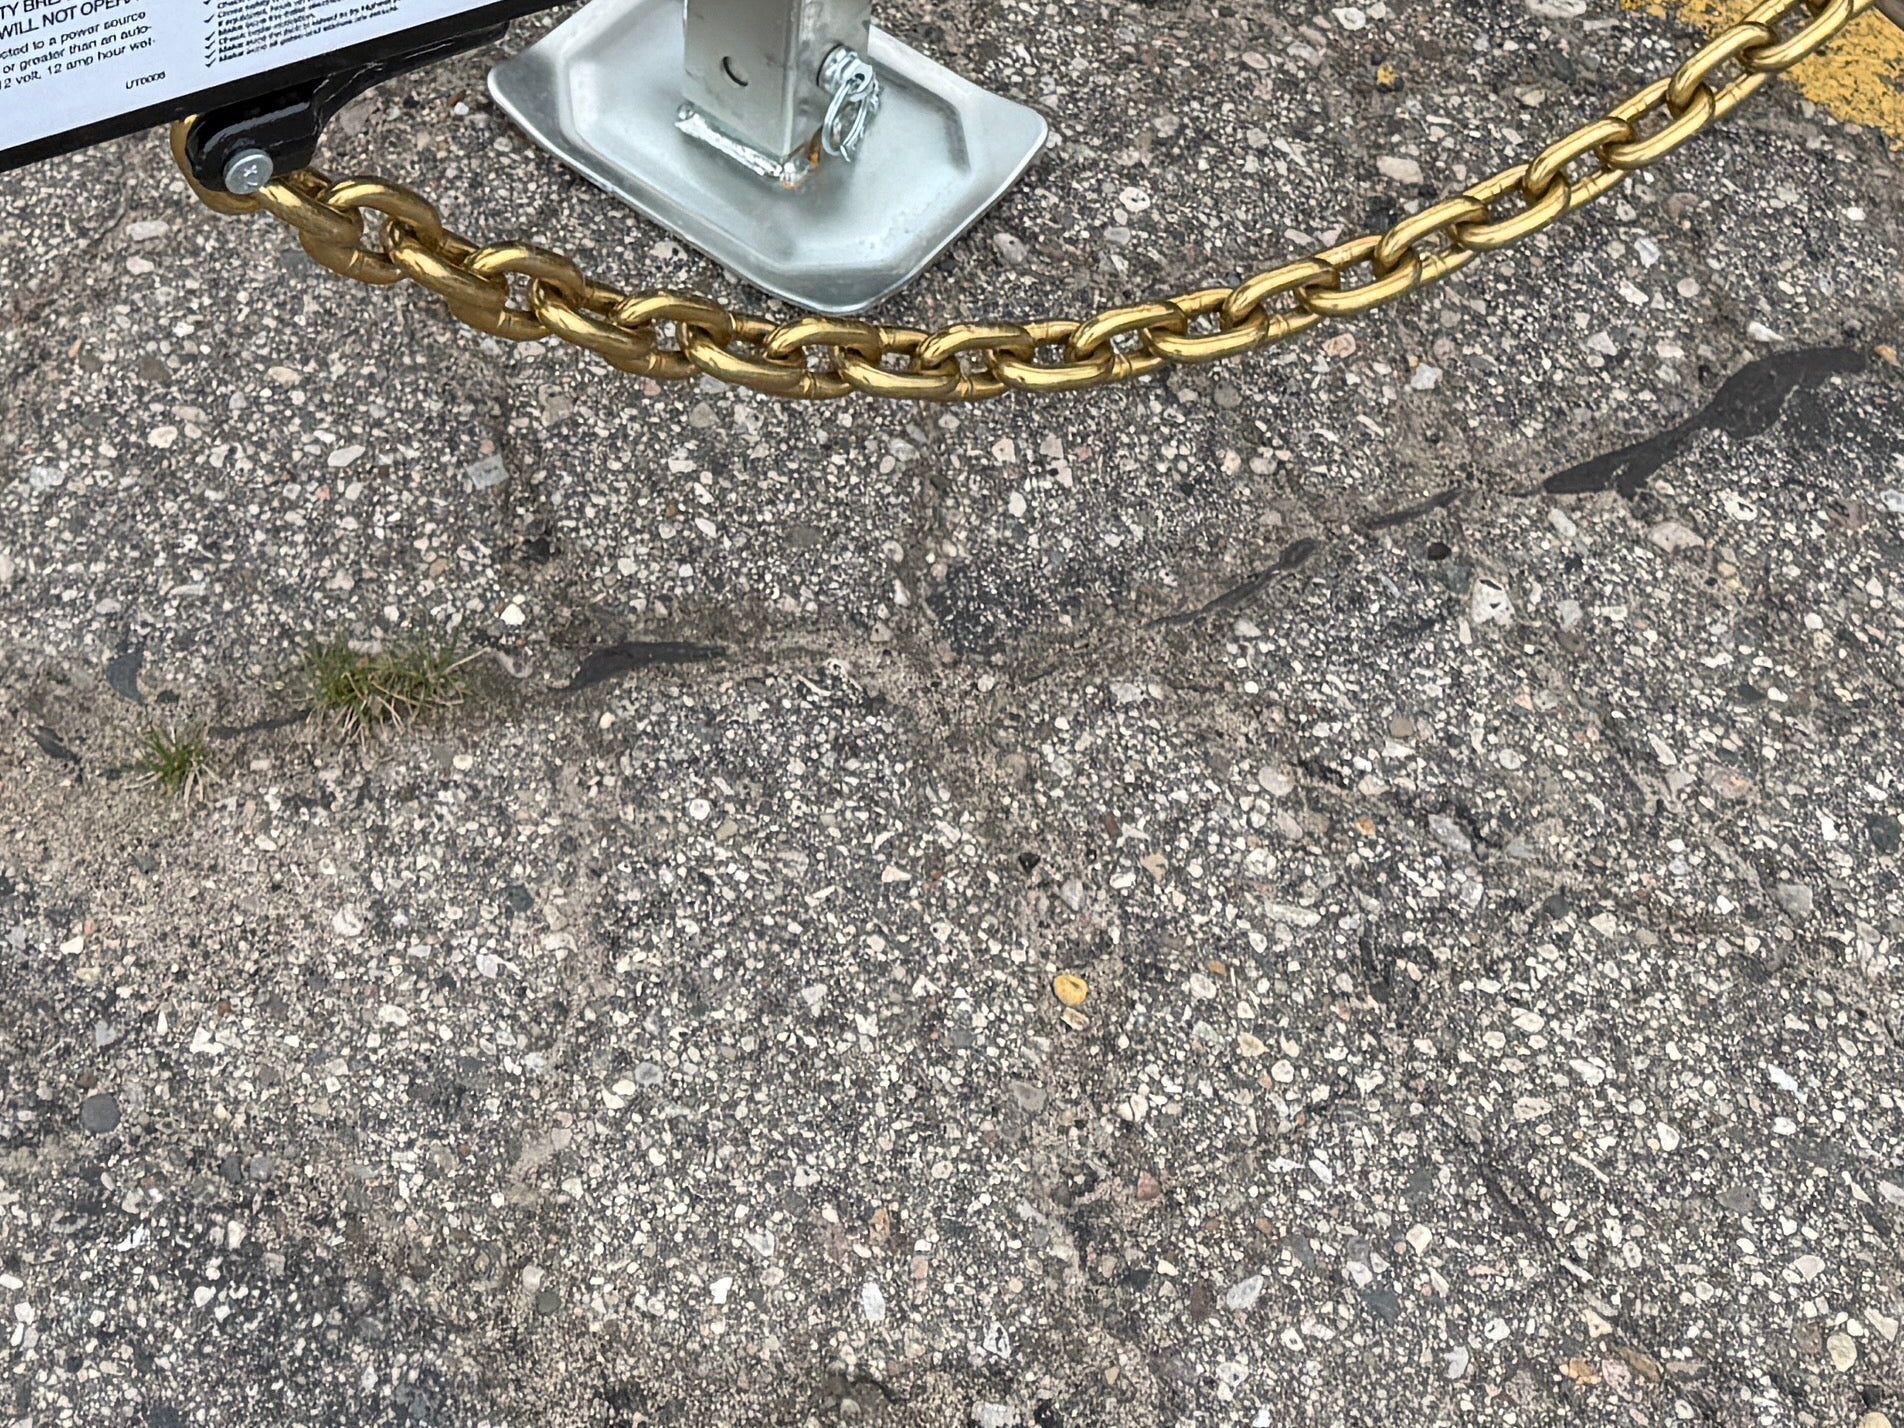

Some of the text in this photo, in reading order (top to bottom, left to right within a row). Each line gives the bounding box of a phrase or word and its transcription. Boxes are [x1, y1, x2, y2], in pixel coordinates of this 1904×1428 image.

[32, 39, 45, 51] to
[49, 36, 57, 46] a
[60, 23, 100, 45] power
[103, 11, 146, 30] source
[42, 5, 77, 27] NOT
[2, 62, 15, 75] or
[19, 48, 65, 72] greater
[69, 39, 97, 55] than
[100, 34, 116, 46] an
[47, 63, 62, 75] 12
[66, 55, 94, 71] amp
[97, 45, 126, 61] hour
